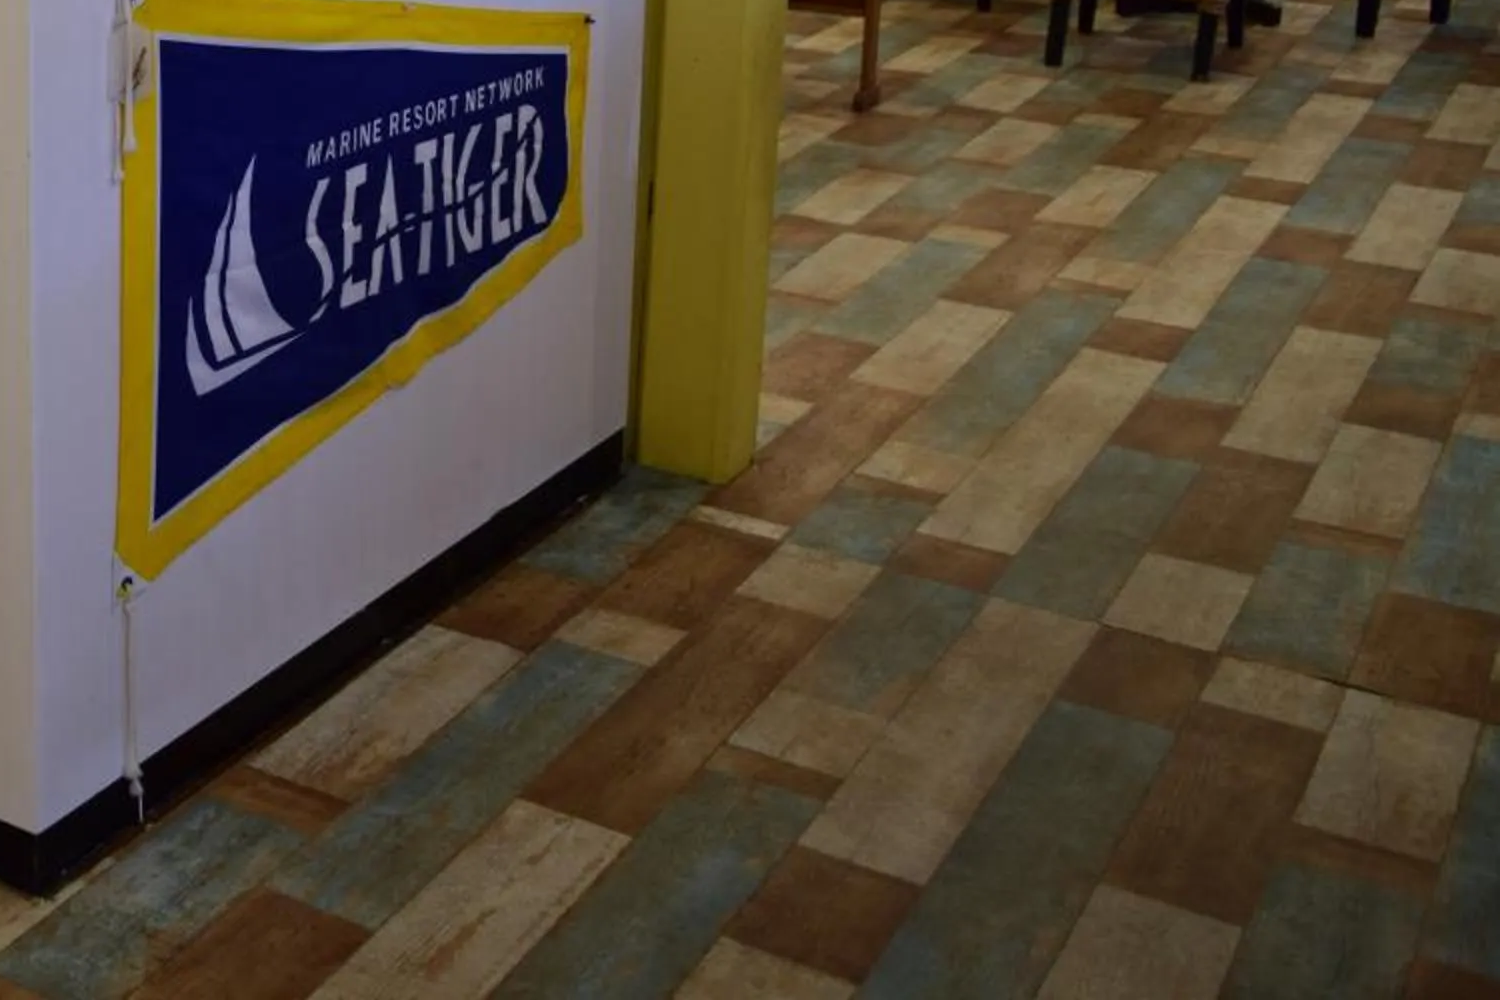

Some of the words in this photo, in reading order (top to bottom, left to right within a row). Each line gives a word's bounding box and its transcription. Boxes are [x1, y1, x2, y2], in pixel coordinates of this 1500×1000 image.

[306, 117, 383, 168] MARINE
[389, 94, 460, 138] RESORT
[464, 65, 547, 114] NETWORK
